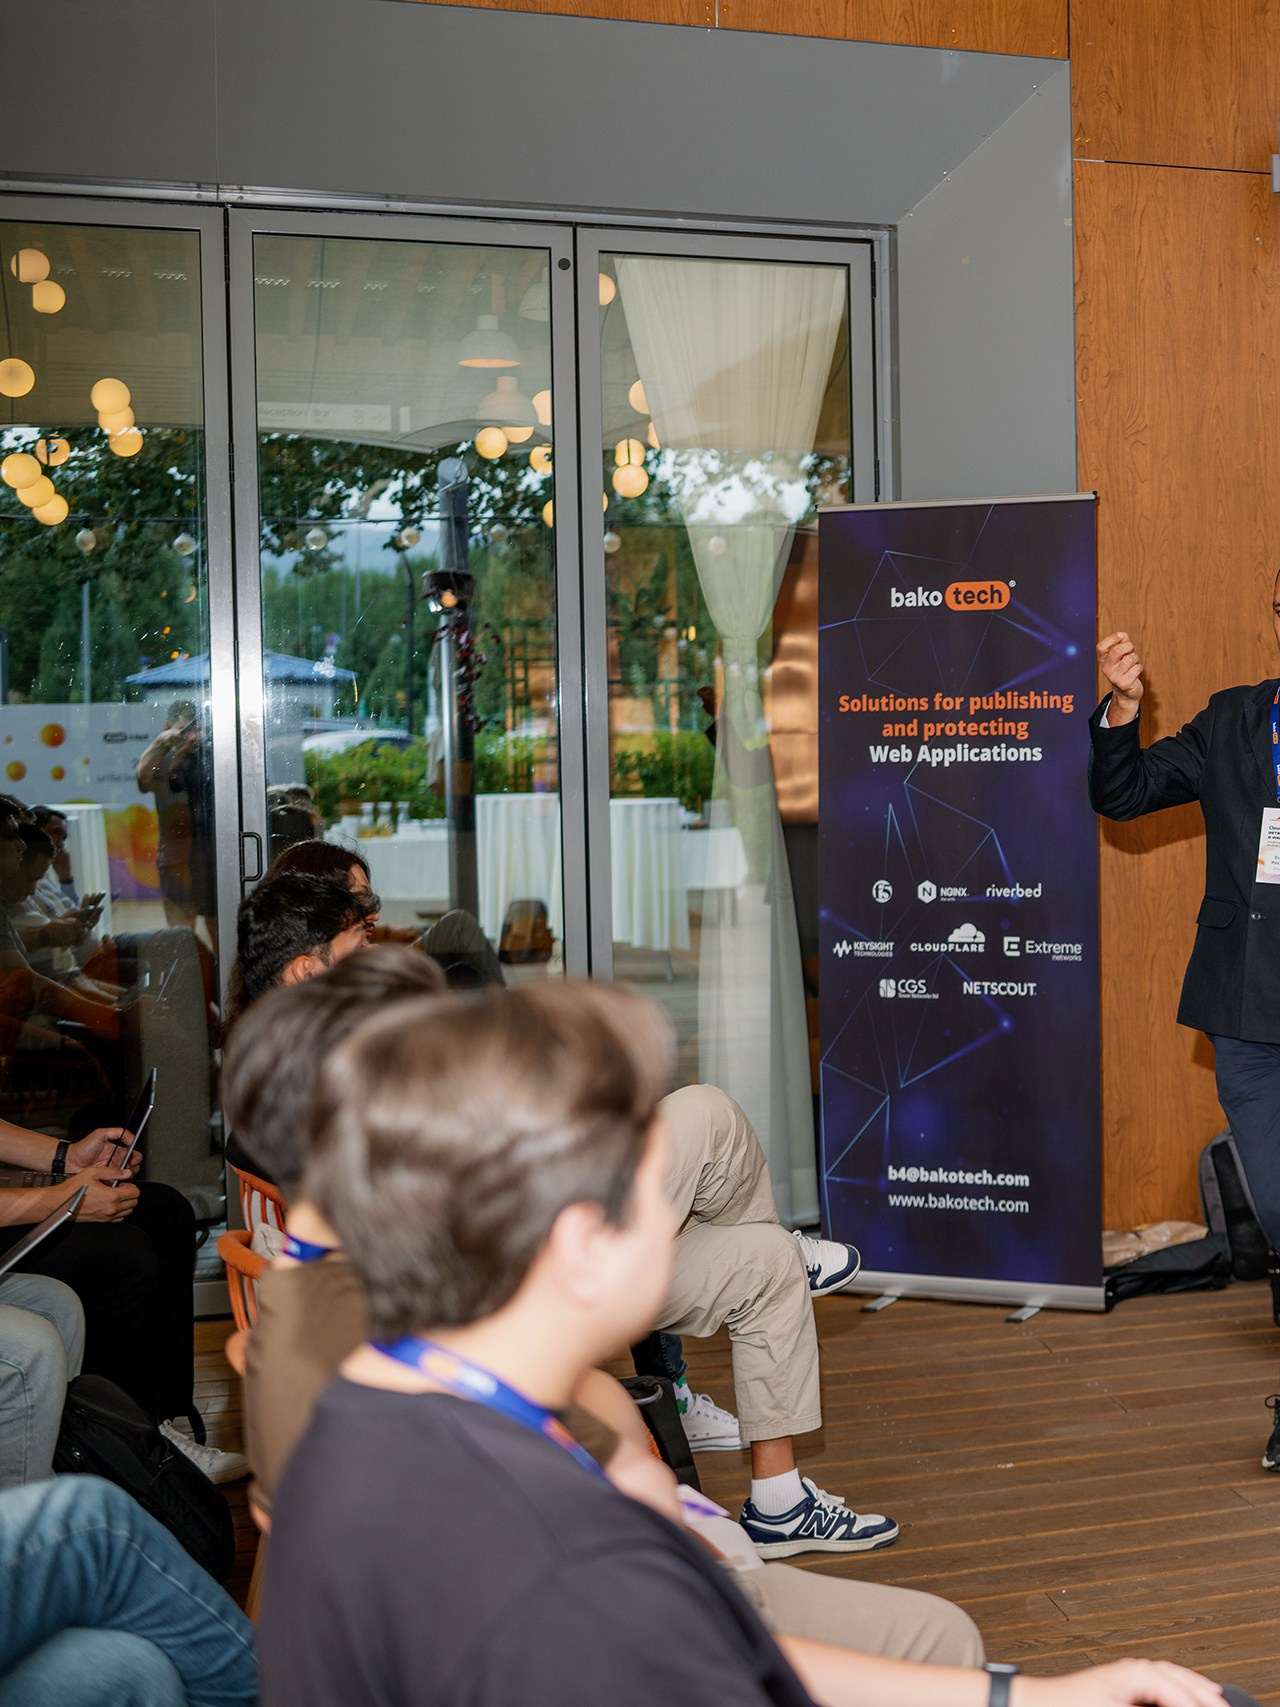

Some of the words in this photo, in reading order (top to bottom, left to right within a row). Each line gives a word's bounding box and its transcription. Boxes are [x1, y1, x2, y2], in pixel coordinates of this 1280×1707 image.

[839, 693, 929, 712] Solutions
[933, 693, 965, 711] for
[969, 691, 1075, 715] publishing
[882, 718, 919, 737] and
[923, 717, 1030, 741] protecting
[869, 745, 913, 763] Web
[917, 743, 1043, 767] Applications
[940, 887, 968, 897] NGINX
[986, 882, 1042, 898] riverbed
[853, 941, 895, 952] KEYSIGHT
[853, 950, 894, 958] TECHNOLOGIES
[910, 942, 985, 953] CLOUDFLARE
[1025, 940, 1082, 956] Extreme
[1052, 954, 1082, 962] networks
[898, 979, 927, 994] CGS
[888, 1164, 1030, 1187] b4@bakotech.com
[888, 1193, 1030, 1214] www.bakotech.com
